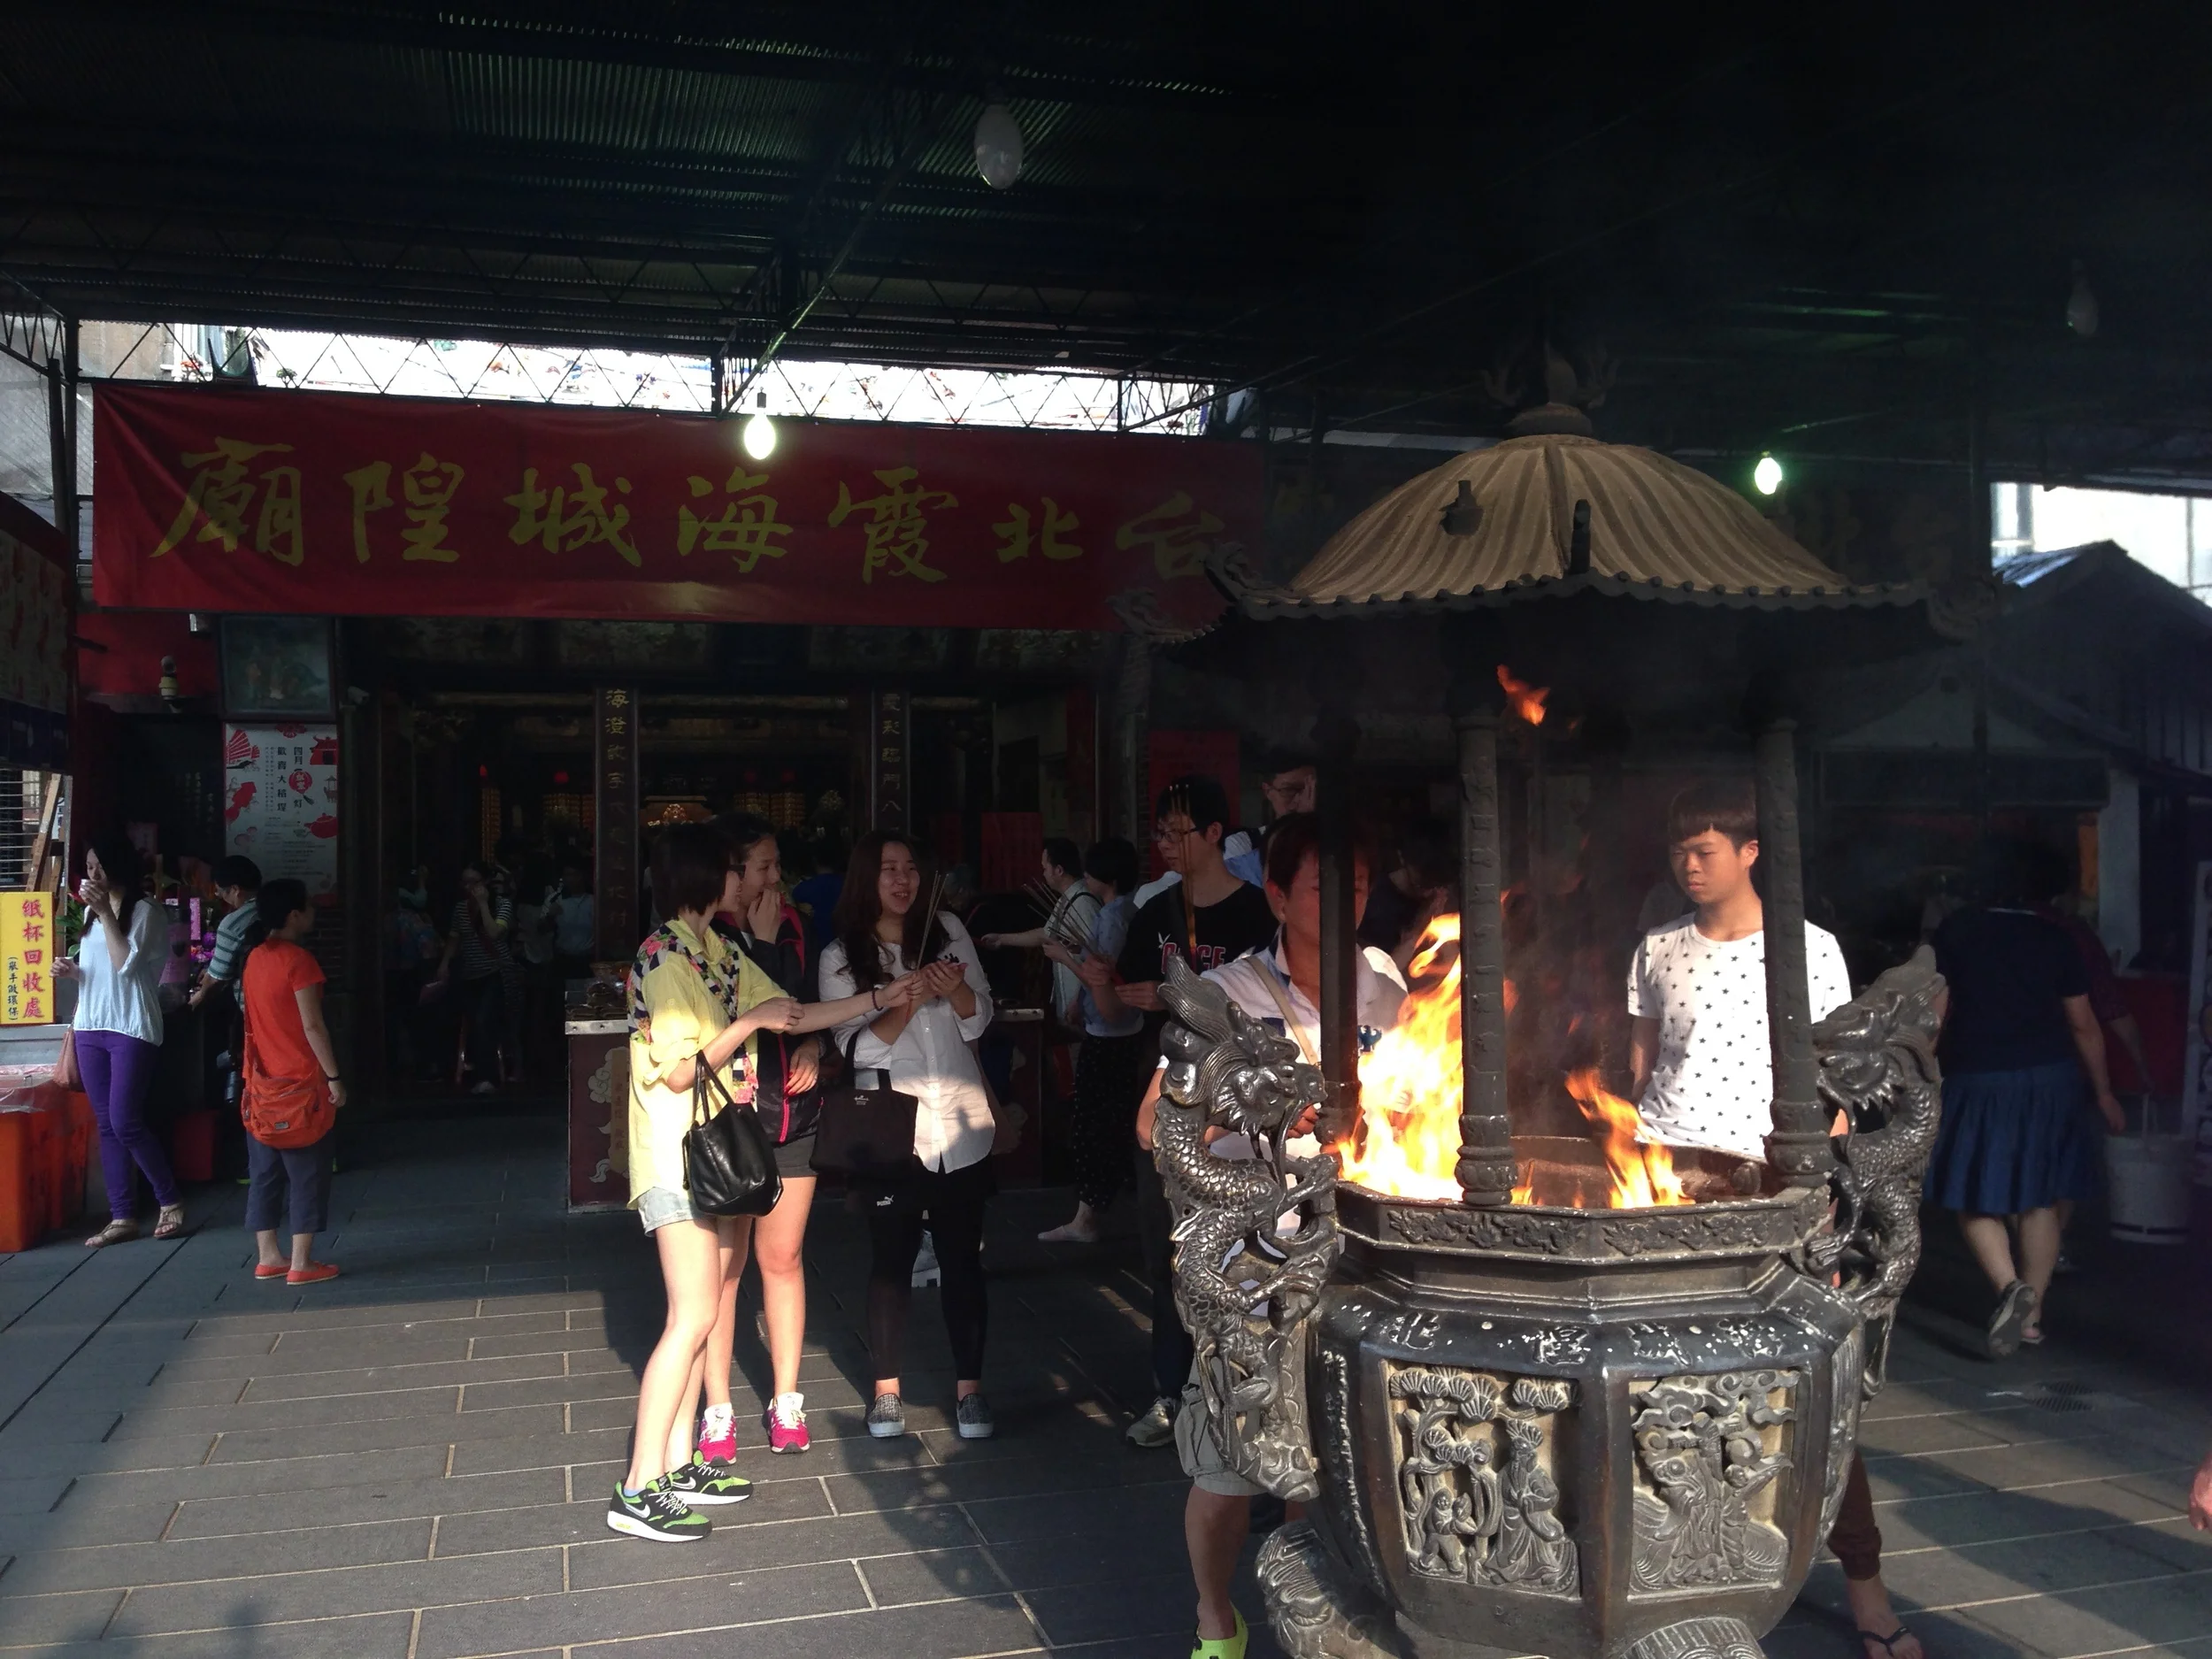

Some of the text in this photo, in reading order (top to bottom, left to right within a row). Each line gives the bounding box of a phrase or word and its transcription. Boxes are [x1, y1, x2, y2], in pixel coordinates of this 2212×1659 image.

[22, 899, 44, 1018] 紙杯回收處
